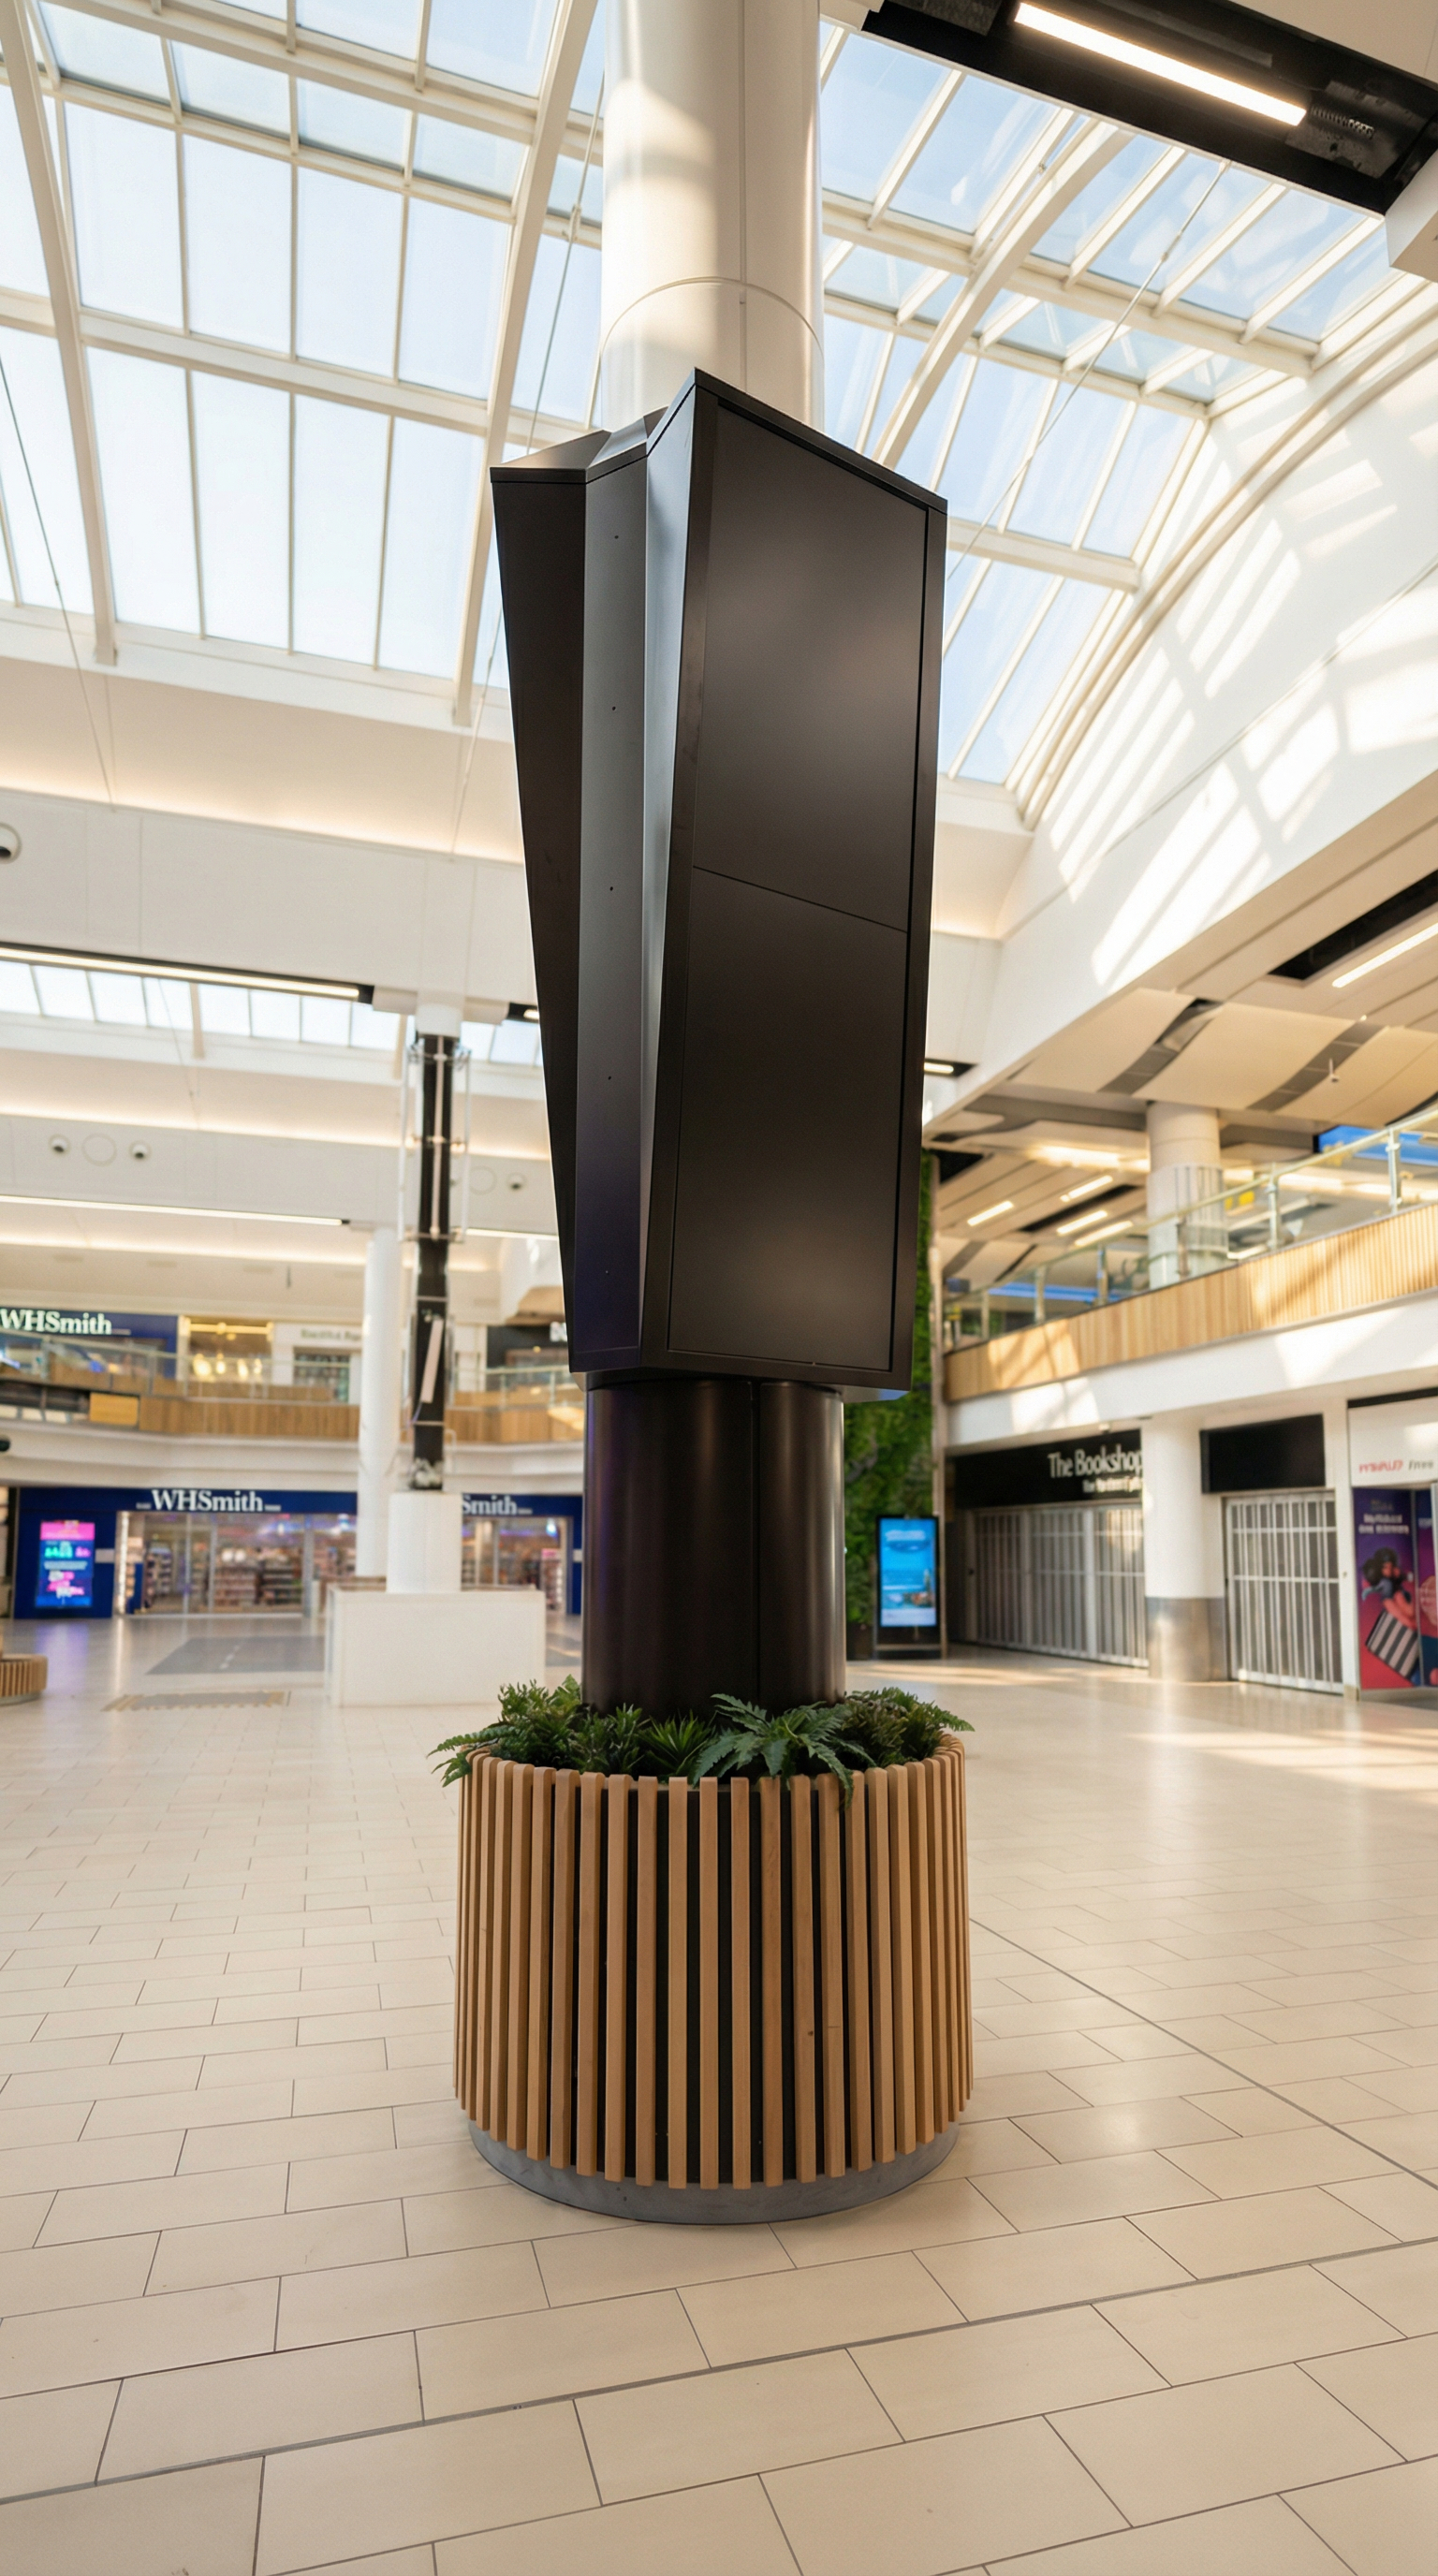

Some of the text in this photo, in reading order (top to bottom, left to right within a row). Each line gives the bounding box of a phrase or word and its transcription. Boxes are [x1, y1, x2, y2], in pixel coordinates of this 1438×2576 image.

[0, 1309, 111, 1335] WHSmith
[1048, 1443, 1142, 1478] The Bookshop
[152, 1489, 263, 1512] WHSmith
